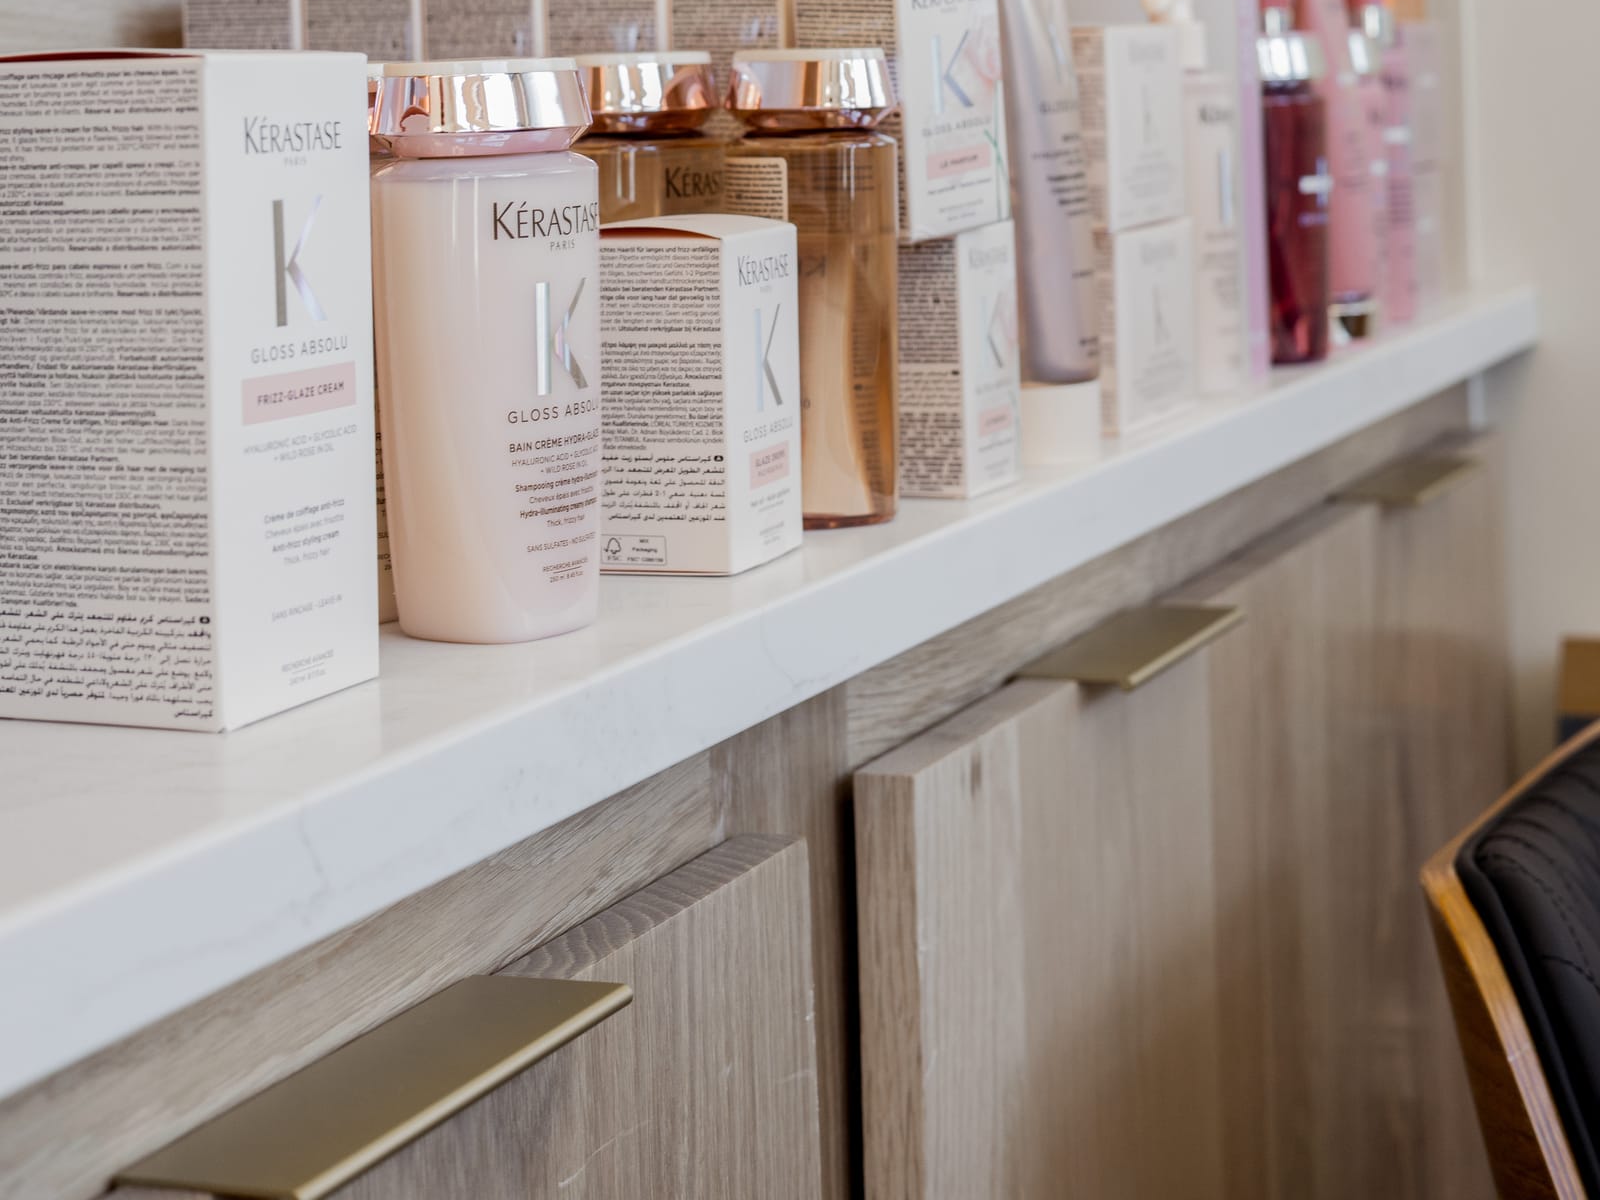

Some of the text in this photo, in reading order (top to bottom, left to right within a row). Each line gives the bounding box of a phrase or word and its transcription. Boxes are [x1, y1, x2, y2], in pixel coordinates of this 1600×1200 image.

[243, 115, 342, 154] KÉRASTASE
[493, 201, 598, 241] KÉRASTASE
[549, 239, 575, 252] PARIS
[737, 254, 790, 287] KÉRASTASE
[251, 335, 349, 364] GLOSS ABSOLU
[317, 381, 345, 395] CREAM
[507, 405, 559, 424] GLOSS
[509, 441, 533, 453] BAIN
